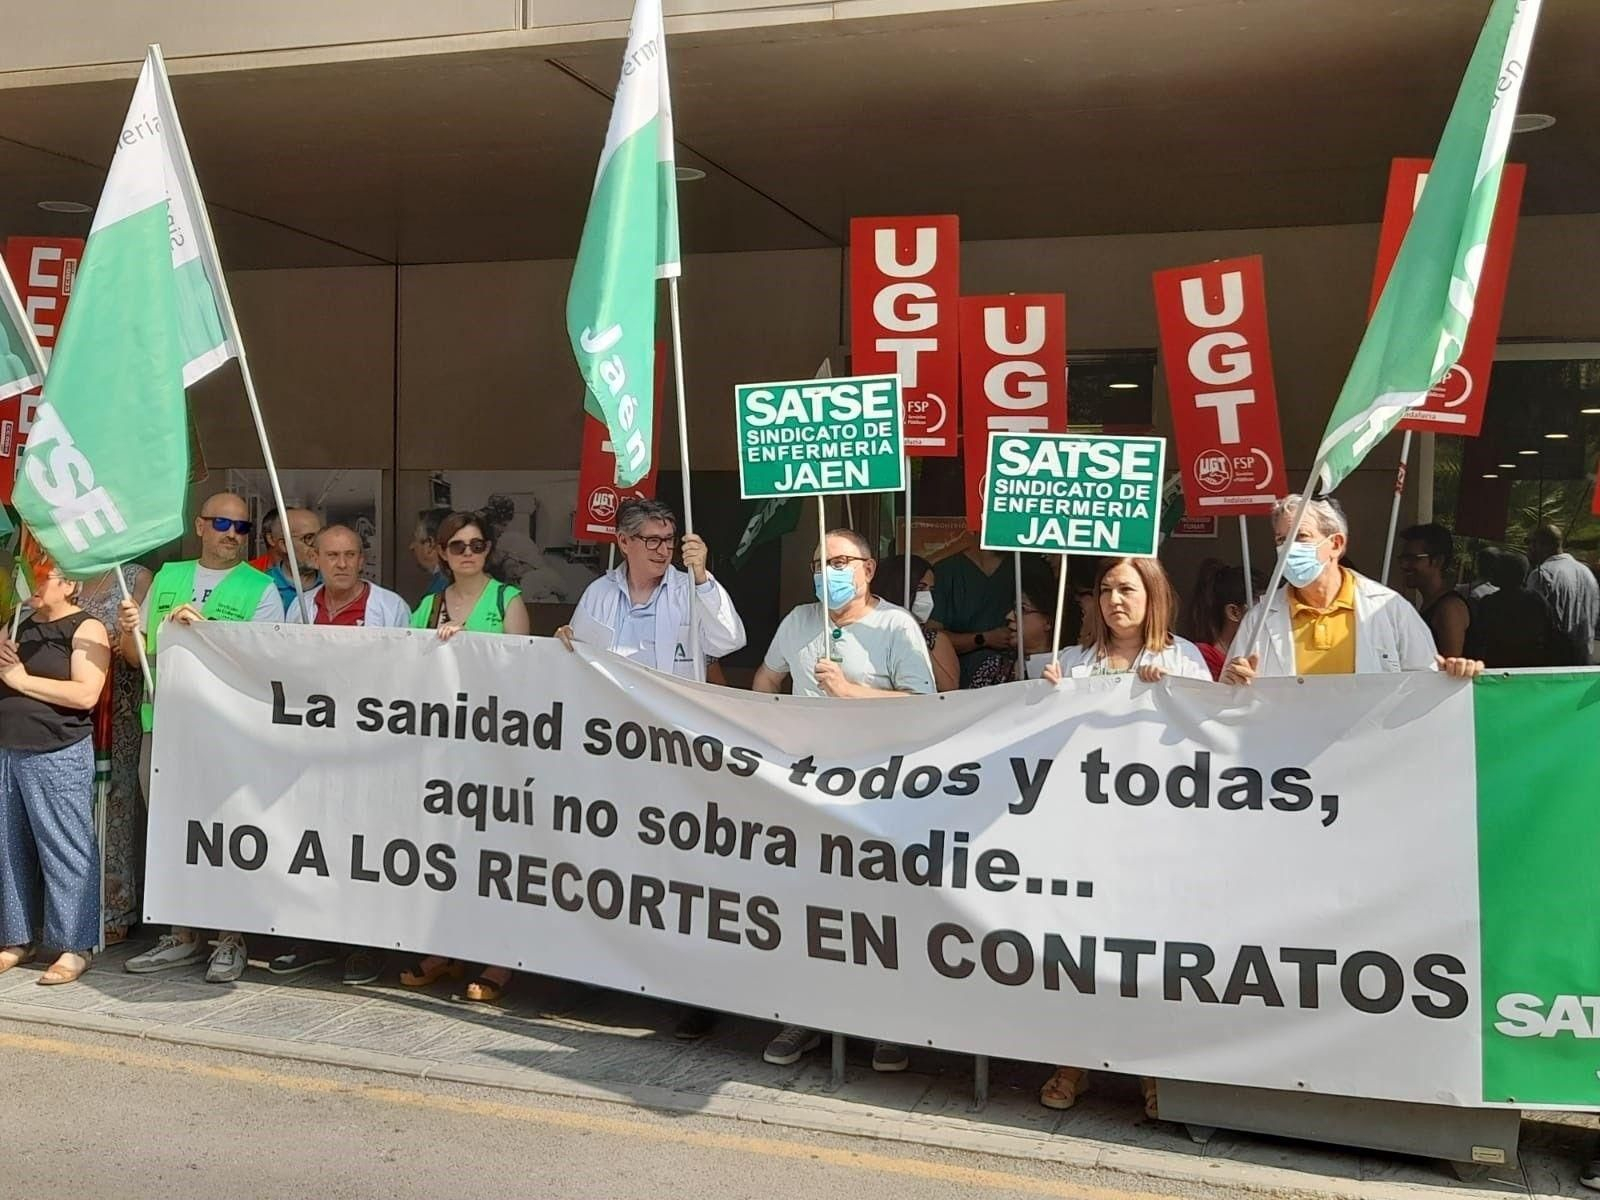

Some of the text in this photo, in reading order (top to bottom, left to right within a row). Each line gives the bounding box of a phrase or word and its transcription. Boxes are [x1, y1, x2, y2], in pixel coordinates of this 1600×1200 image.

[873, 228, 938, 388] UGT
[1180, 271, 1255, 444] UGT
[580, 323, 646, 472] Jaén
[745, 382, 893, 427] SATSE
[907, 400, 929, 413] FSP
[747, 422, 892, 445] SINDICATO DE
[749, 439, 894, 463] ENFERMERIA
[996, 439, 1156, 481] SATSE
[1199, 457, 1255, 474] UGT FSP
[774, 459, 869, 491] JAEN
[994, 478, 1113, 499] SINDICATO
[1119, 484, 1150, 501] DE
[593, 492, 614, 507] UGT
[993, 496, 1149, 519] ENFERMERIA
[1016, 517, 1120, 549] JAEN
[270, 680, 1340, 827] La sanidad somos todos y todas,
[423, 777, 1094, 898] aquí no sobra nadie...
[185, 819, 1470, 1020] NO A LOS RECORTES EN CONTRATOS
